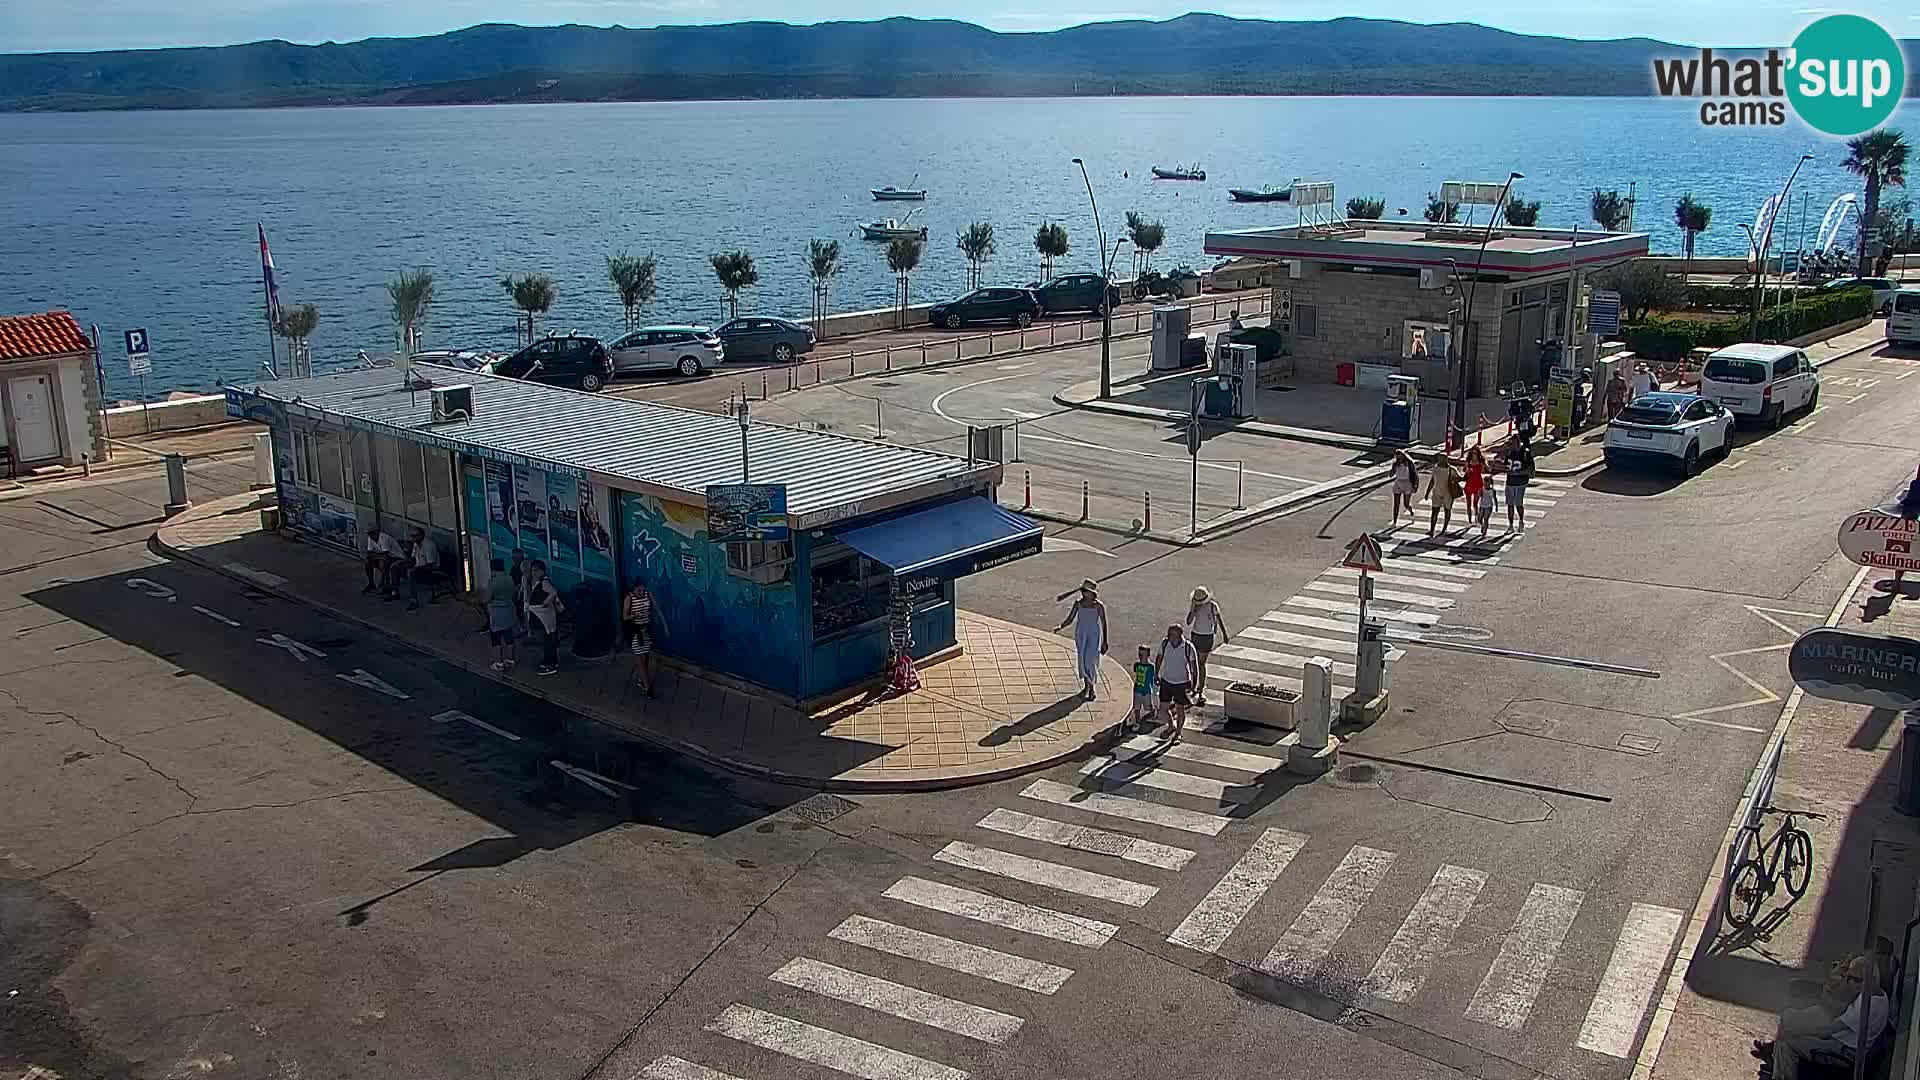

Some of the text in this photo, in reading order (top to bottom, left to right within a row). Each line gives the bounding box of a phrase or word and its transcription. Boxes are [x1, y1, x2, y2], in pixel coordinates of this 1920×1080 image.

[130, 332, 143, 351] P
[494, 449, 526, 466] STATION
[528, 458, 555, 473] TICKET
[556, 463, 583, 479] OFFICE
[1802, 643, 1920, 673] MARINER
[1871, 667, 1897, 681] bar
